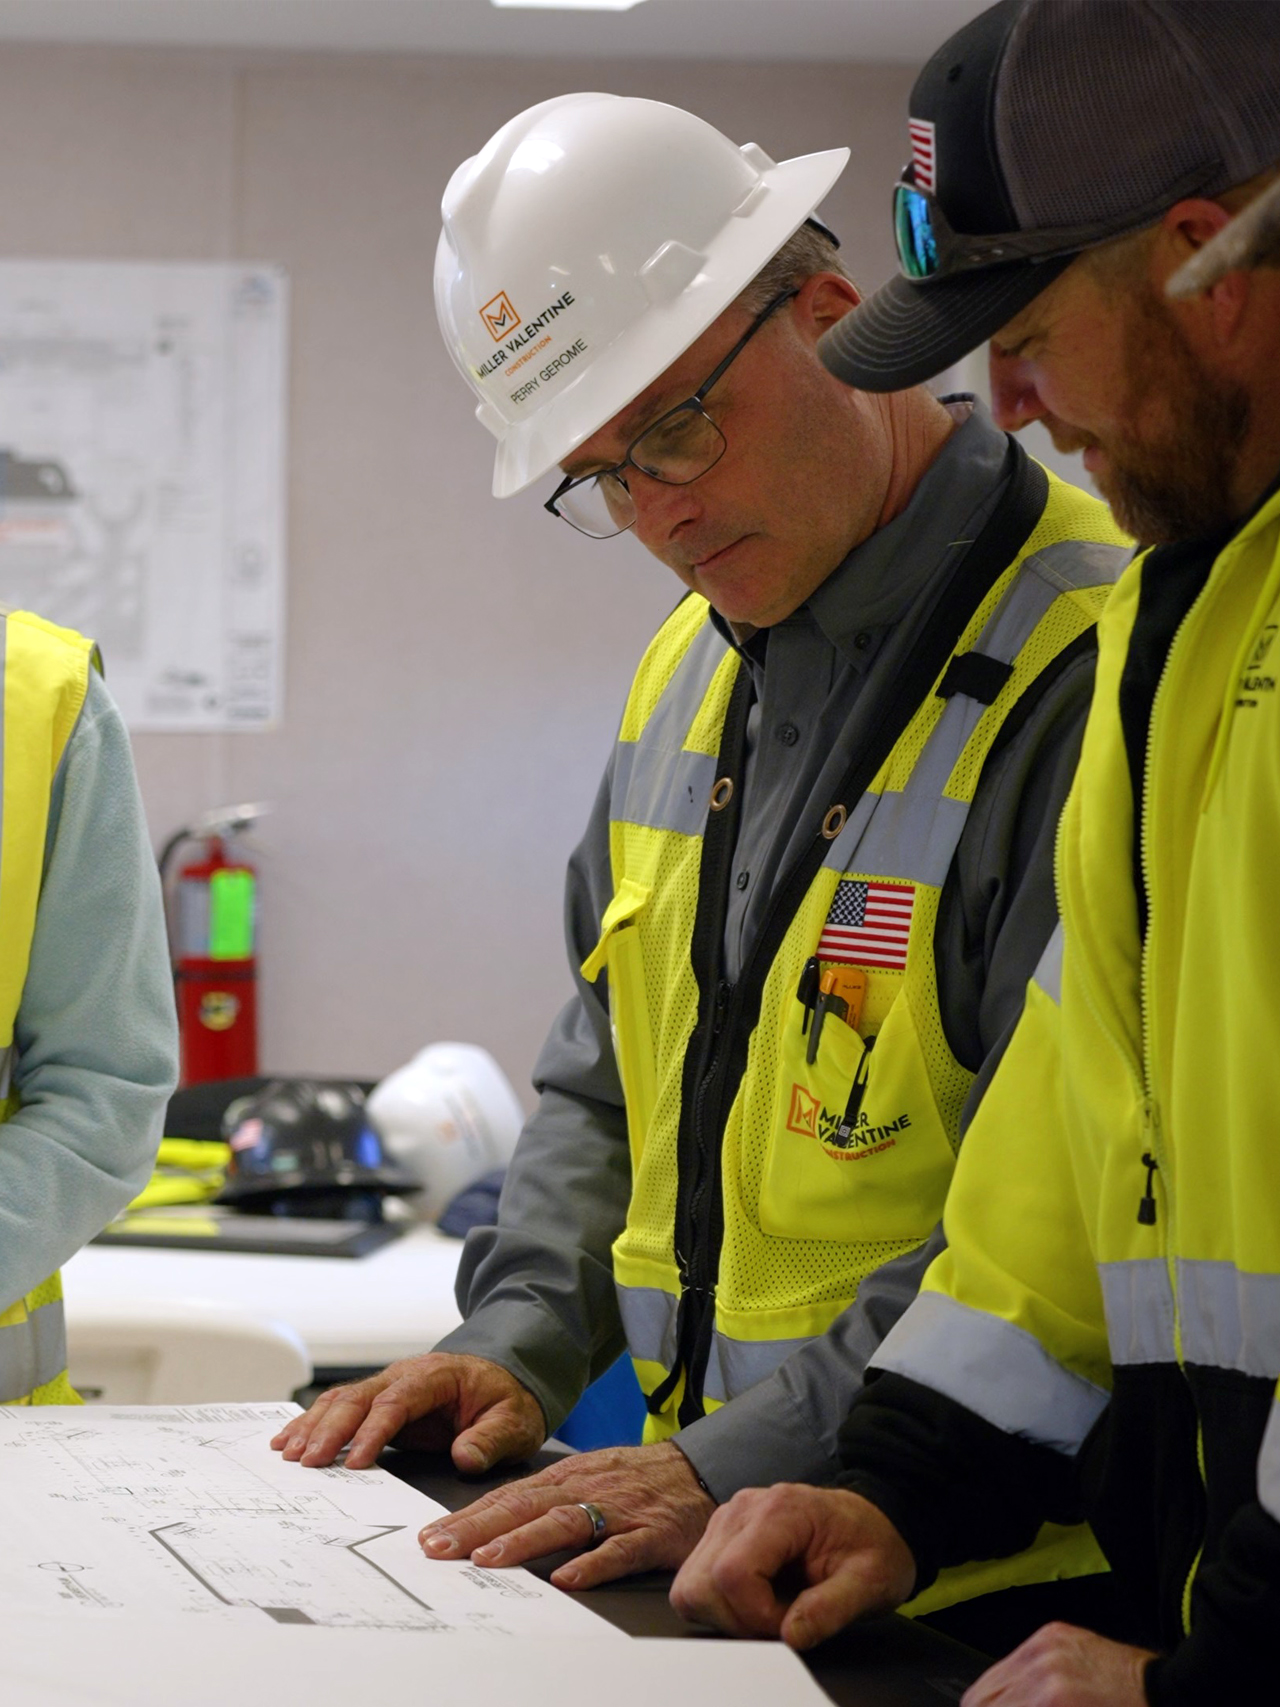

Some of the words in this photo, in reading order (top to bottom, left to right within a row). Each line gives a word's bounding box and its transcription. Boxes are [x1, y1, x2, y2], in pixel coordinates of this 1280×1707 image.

[475, 349, 509, 380] MILLER
[505, 291, 576, 354] VALENTINE
[504, 335, 553, 377] CONSTRUCTION
[510, 376, 542, 405] PERRY
[538, 337, 589, 382] GEROME
